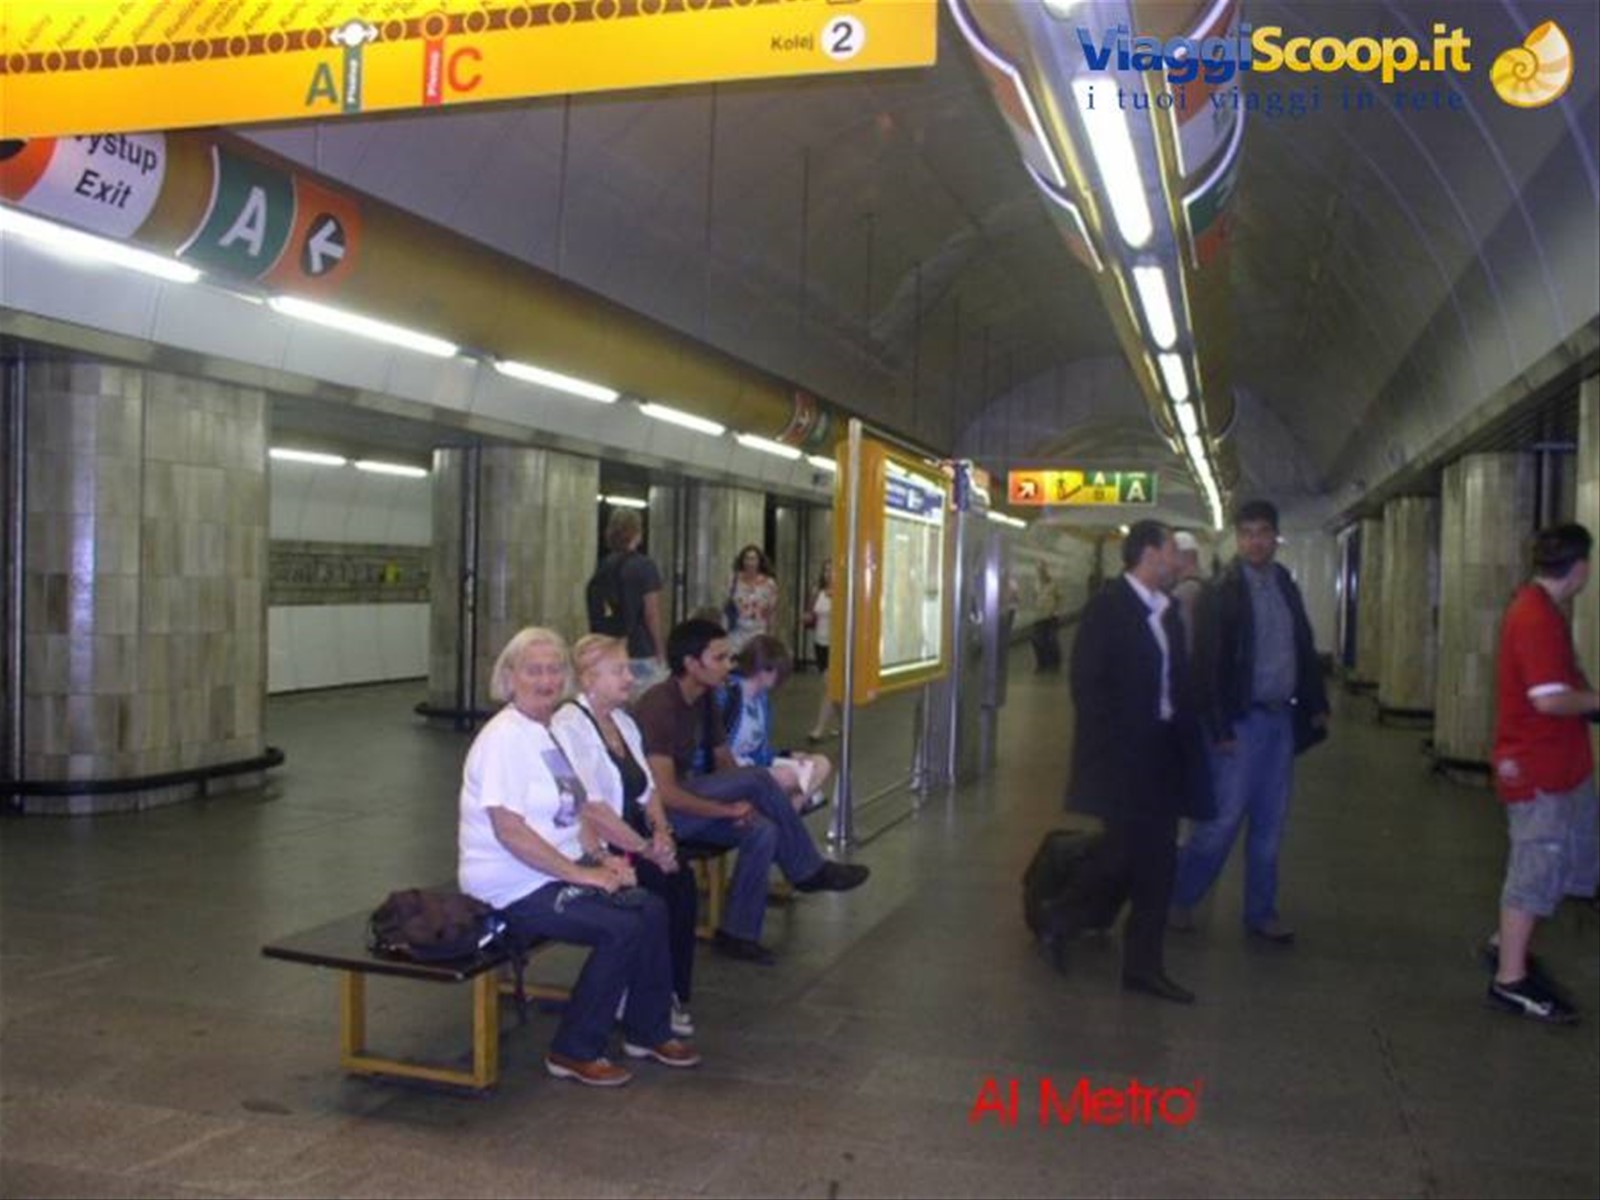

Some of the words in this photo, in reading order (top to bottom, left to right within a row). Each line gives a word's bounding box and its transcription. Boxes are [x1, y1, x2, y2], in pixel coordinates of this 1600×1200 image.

[771, 35, 814, 51] Kolej
[832, 21, 853, 52] 2
[305, 62, 338, 106] A
[448, 47, 482, 92] C
[75, 133, 157, 174] ystup
[75, 169, 131, 208] Exit
[219, 185, 267, 256] A
